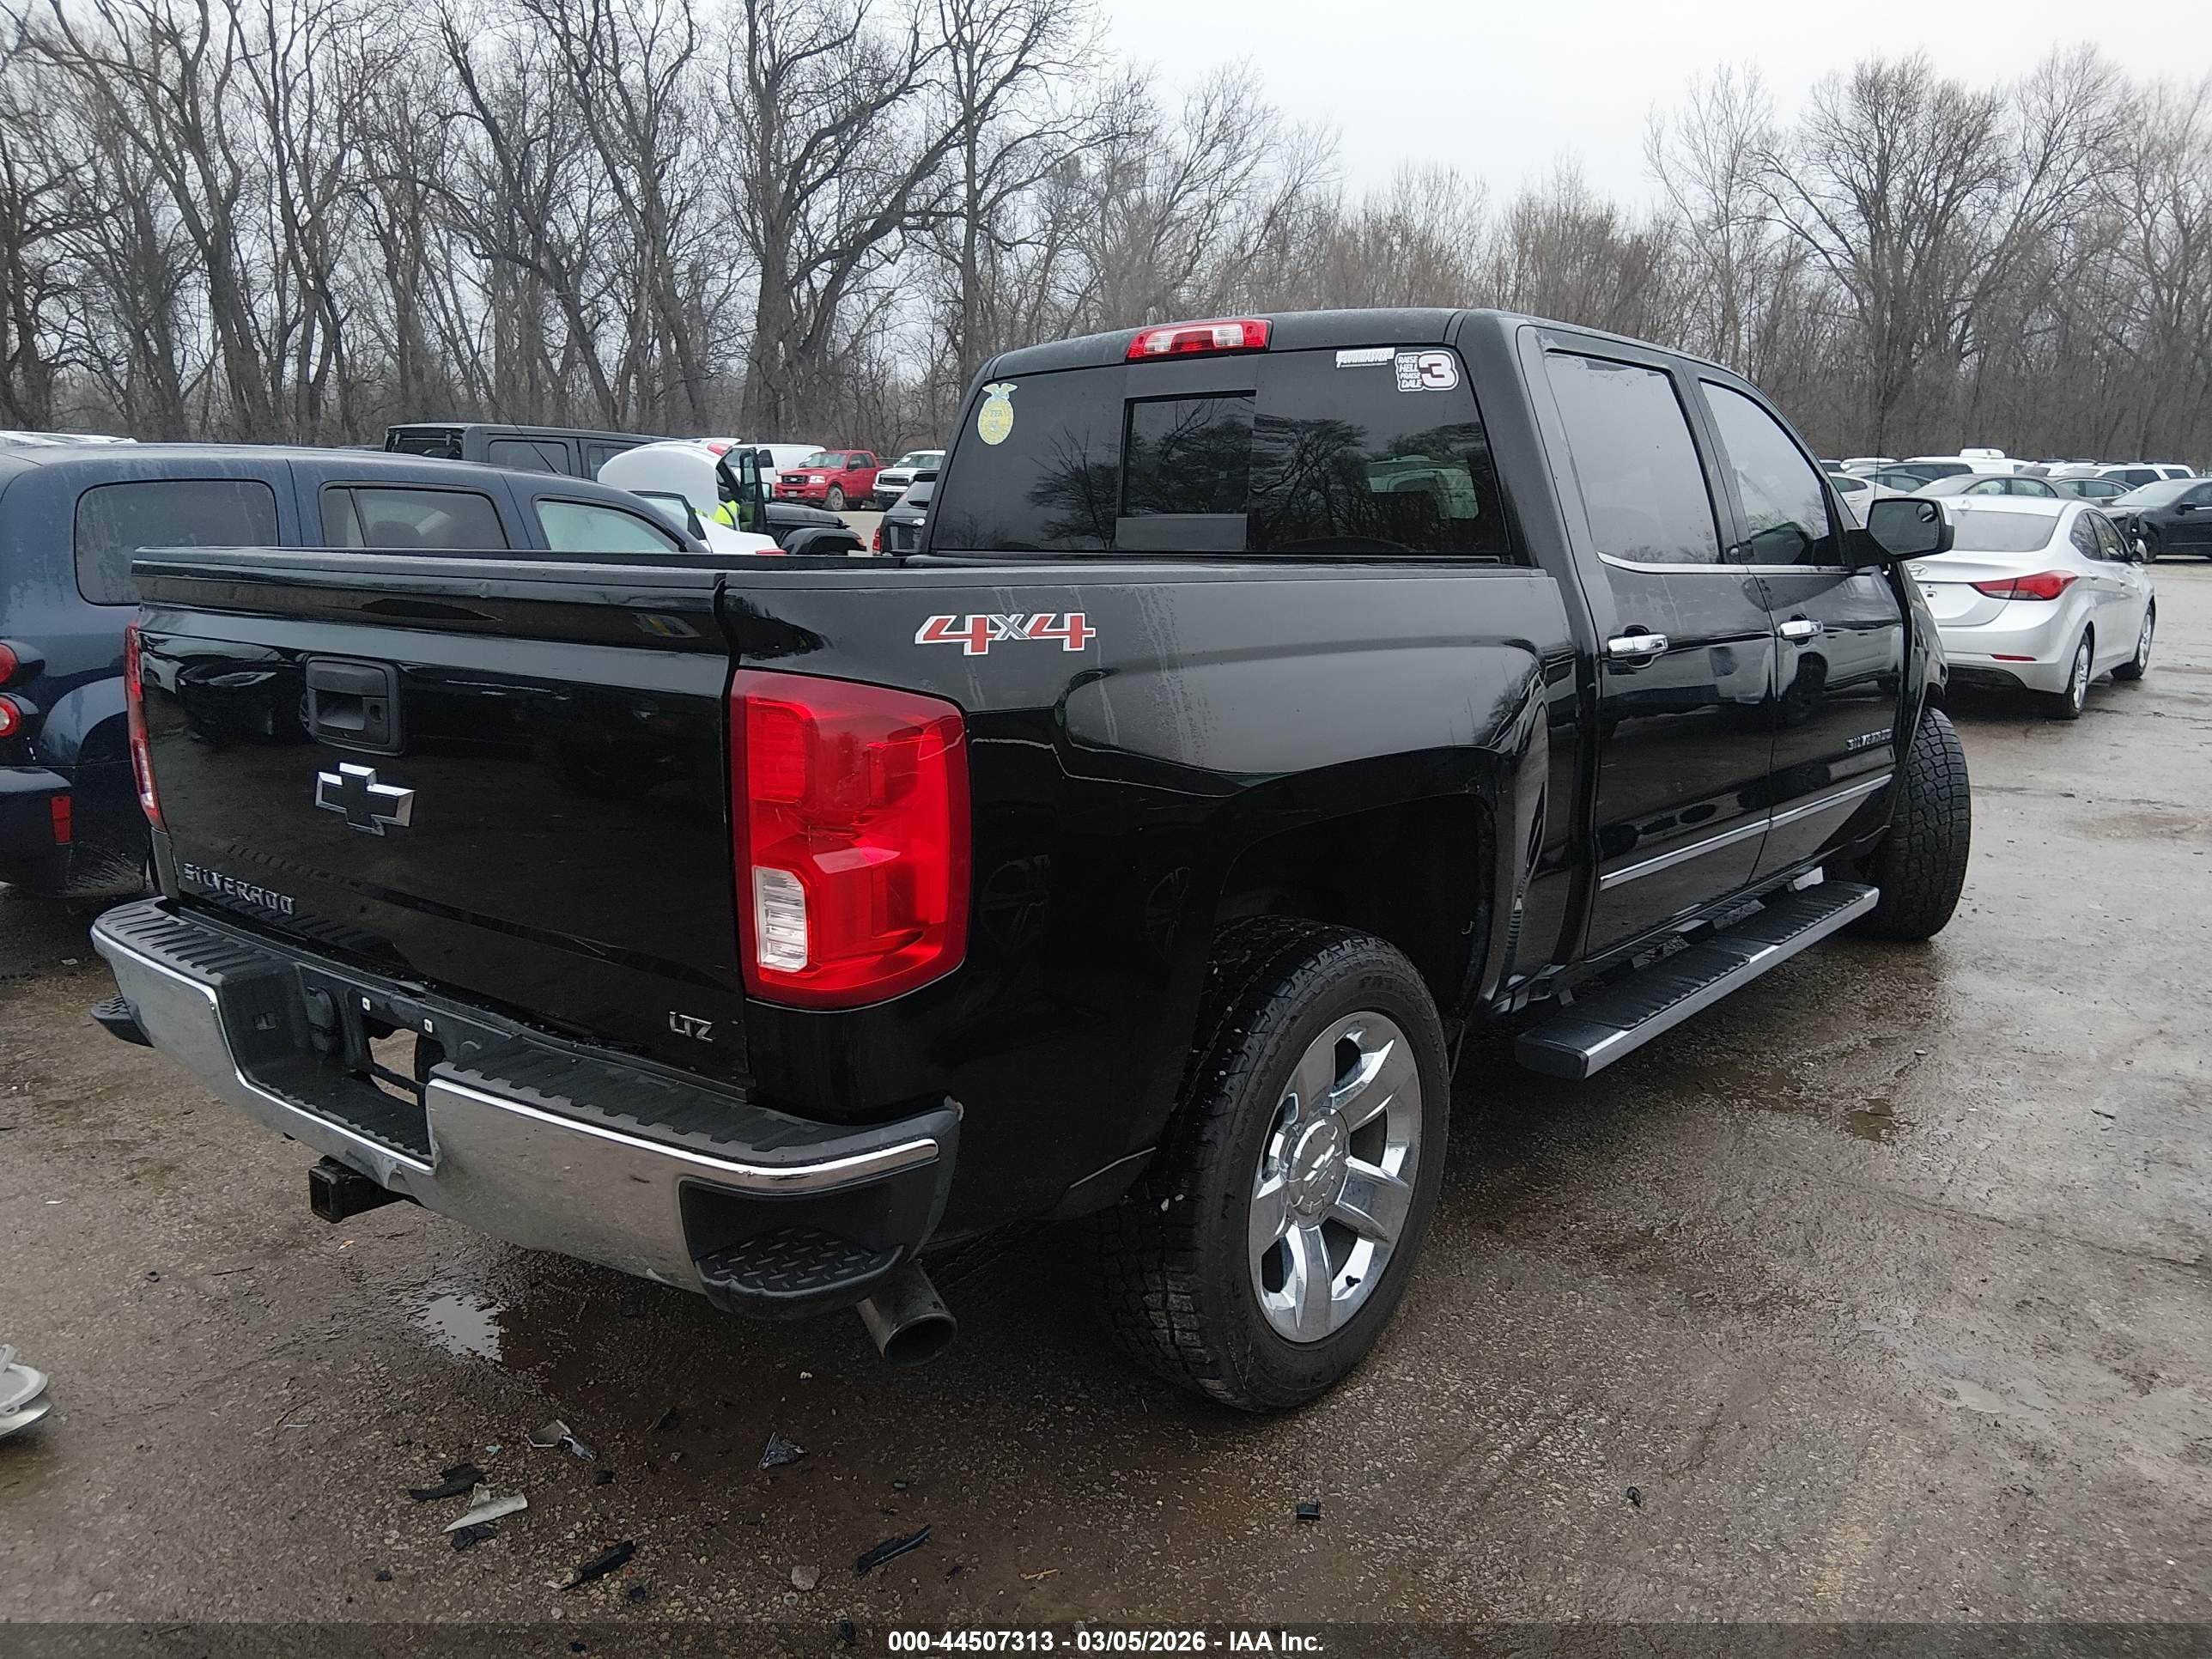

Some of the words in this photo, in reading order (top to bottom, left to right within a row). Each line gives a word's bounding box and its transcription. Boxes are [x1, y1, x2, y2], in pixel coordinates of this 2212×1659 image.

[1398, 356, 1419, 364] RAISE
[1399, 363, 1419, 373] HELL
[1419, 354, 1456, 387] 3
[1401, 379, 1423, 389] DALE
[183, 862, 295, 916] SILVERADO
[669, 1011, 714, 1042] LTZ
